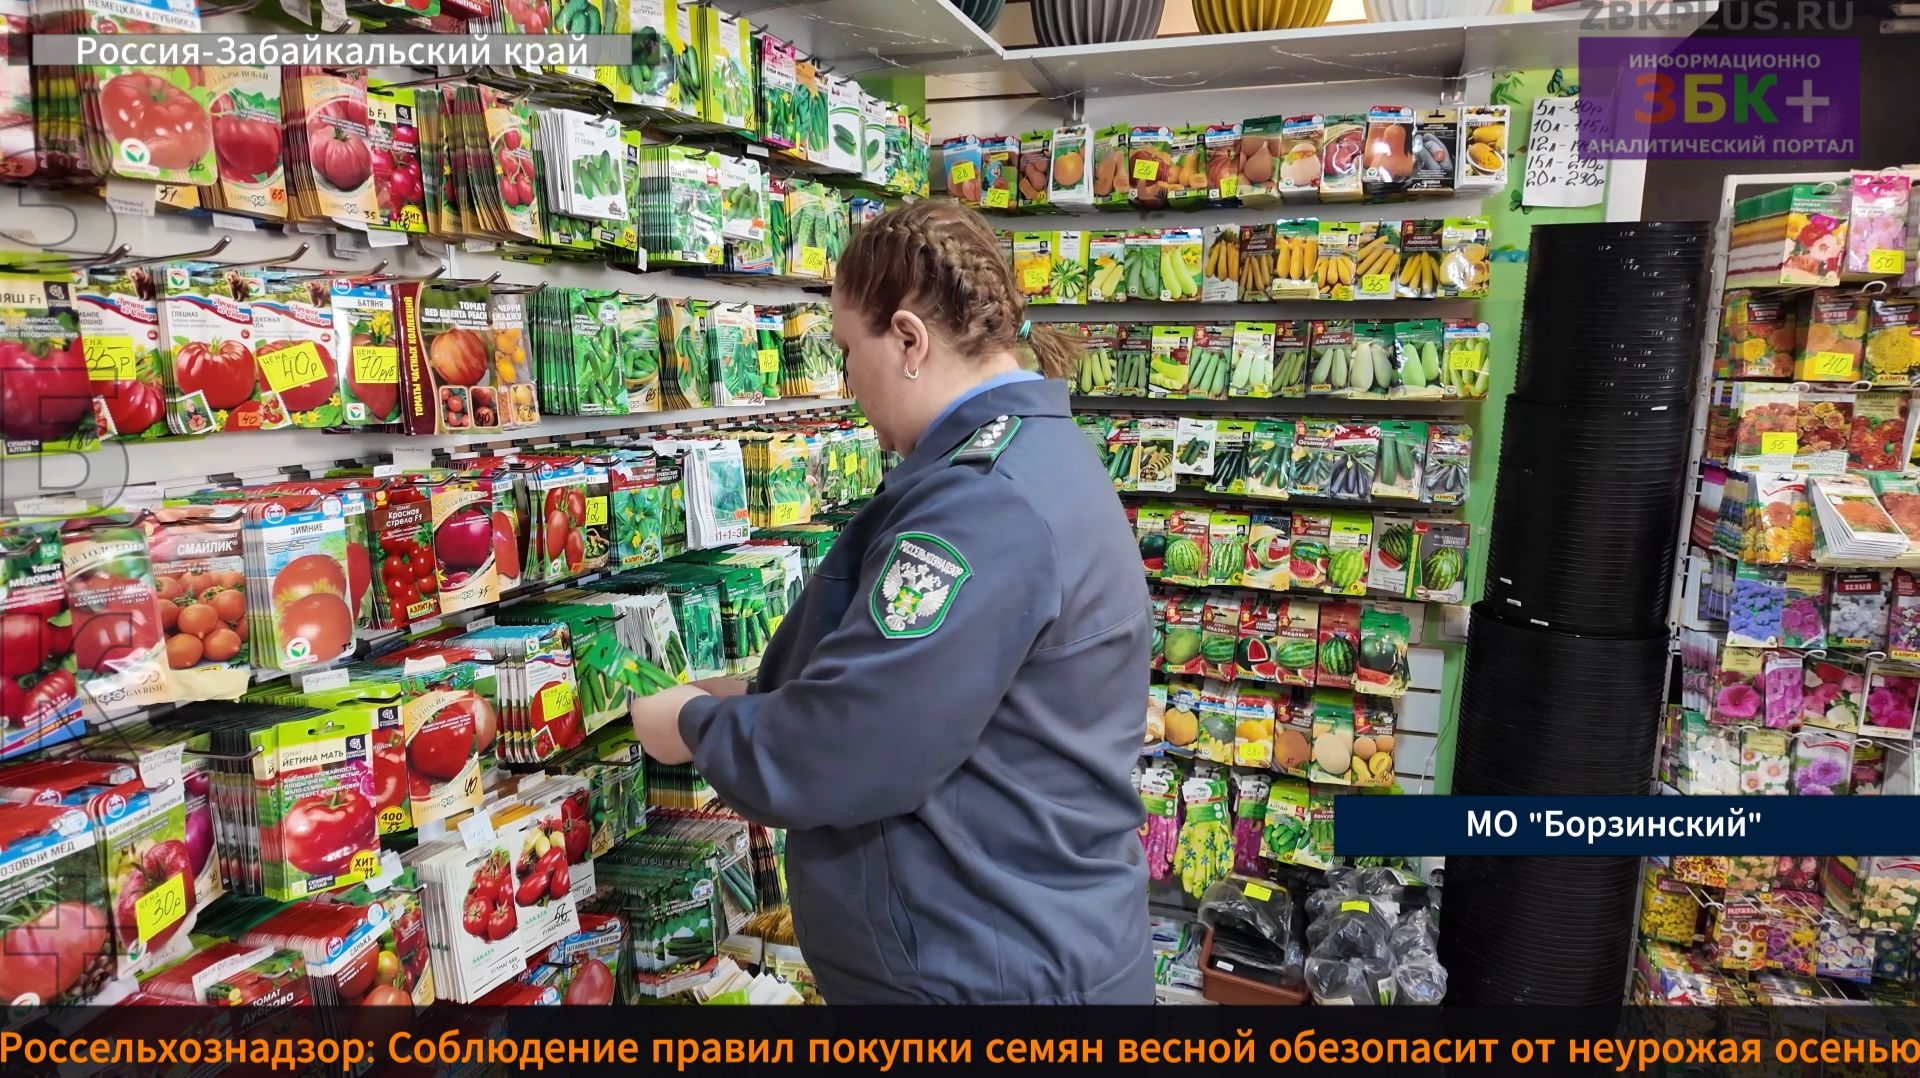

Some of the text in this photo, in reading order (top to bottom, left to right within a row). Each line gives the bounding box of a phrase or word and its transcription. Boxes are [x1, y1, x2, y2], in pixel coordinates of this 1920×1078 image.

[1876, 256, 1894, 269] 50
[1369, 278, 1384, 292] 35
[357, 299, 384, 308] БАТЯНЯ
[459, 301, 487, 310] ТОМАТ
[424, 308, 439, 317] RED
[468, 311, 487, 320] PEACH
[262, 353, 288, 365] ЦЕНА
[404, 296, 424, 416] ТОМАТЫ ЧАСТНЫХ КОЛЛЕКЦИЙ
[1823, 359, 1849, 373] 40
[241, 413, 258, 424] 40
[388, 508, 420, 520] Красная
[290, 522, 324, 535] ЗИМНИЕ
[386, 518, 412, 528] стрела
[624, 555, 644, 564] АЭЛИТА
[899, 540, 965, 578] РОССЕЛЬХОЗНАДЗОР
[32, 563, 62, 574] Томат
[9, 571, 62, 588] МЕДОВЫЙ
[1845, 583, 1872, 591] БЕЛЫЙ
[408, 602, 433, 614] АЭЛИТА
[281, 751, 344, 767] ЙЕТИНА МАТЬ
[283, 773, 313, 784] ВЫСОКАЯ
[284, 780, 306, 789] ПЛОДЫ
[306, 777, 327, 786] ОЧЕНЬ
[284, 787, 303, 796] МАЛО
[295, 790, 320, 799] ТРЕБУЕТ
[380, 812, 403, 821] 400
[109, 812, 151, 835] КАРТОФЕЛЬНЫЙ
[50, 841, 75, 857] МЕД
[353, 857, 374, 868] ХИТ
[152, 891, 181, 926] 30р
[350, 934, 372, 957] САНЬКА
[566, 934, 620, 952] ШТАМБОВЫЙ КОРОЛЬ
[252, 988, 281, 1007] ТОМАТ
